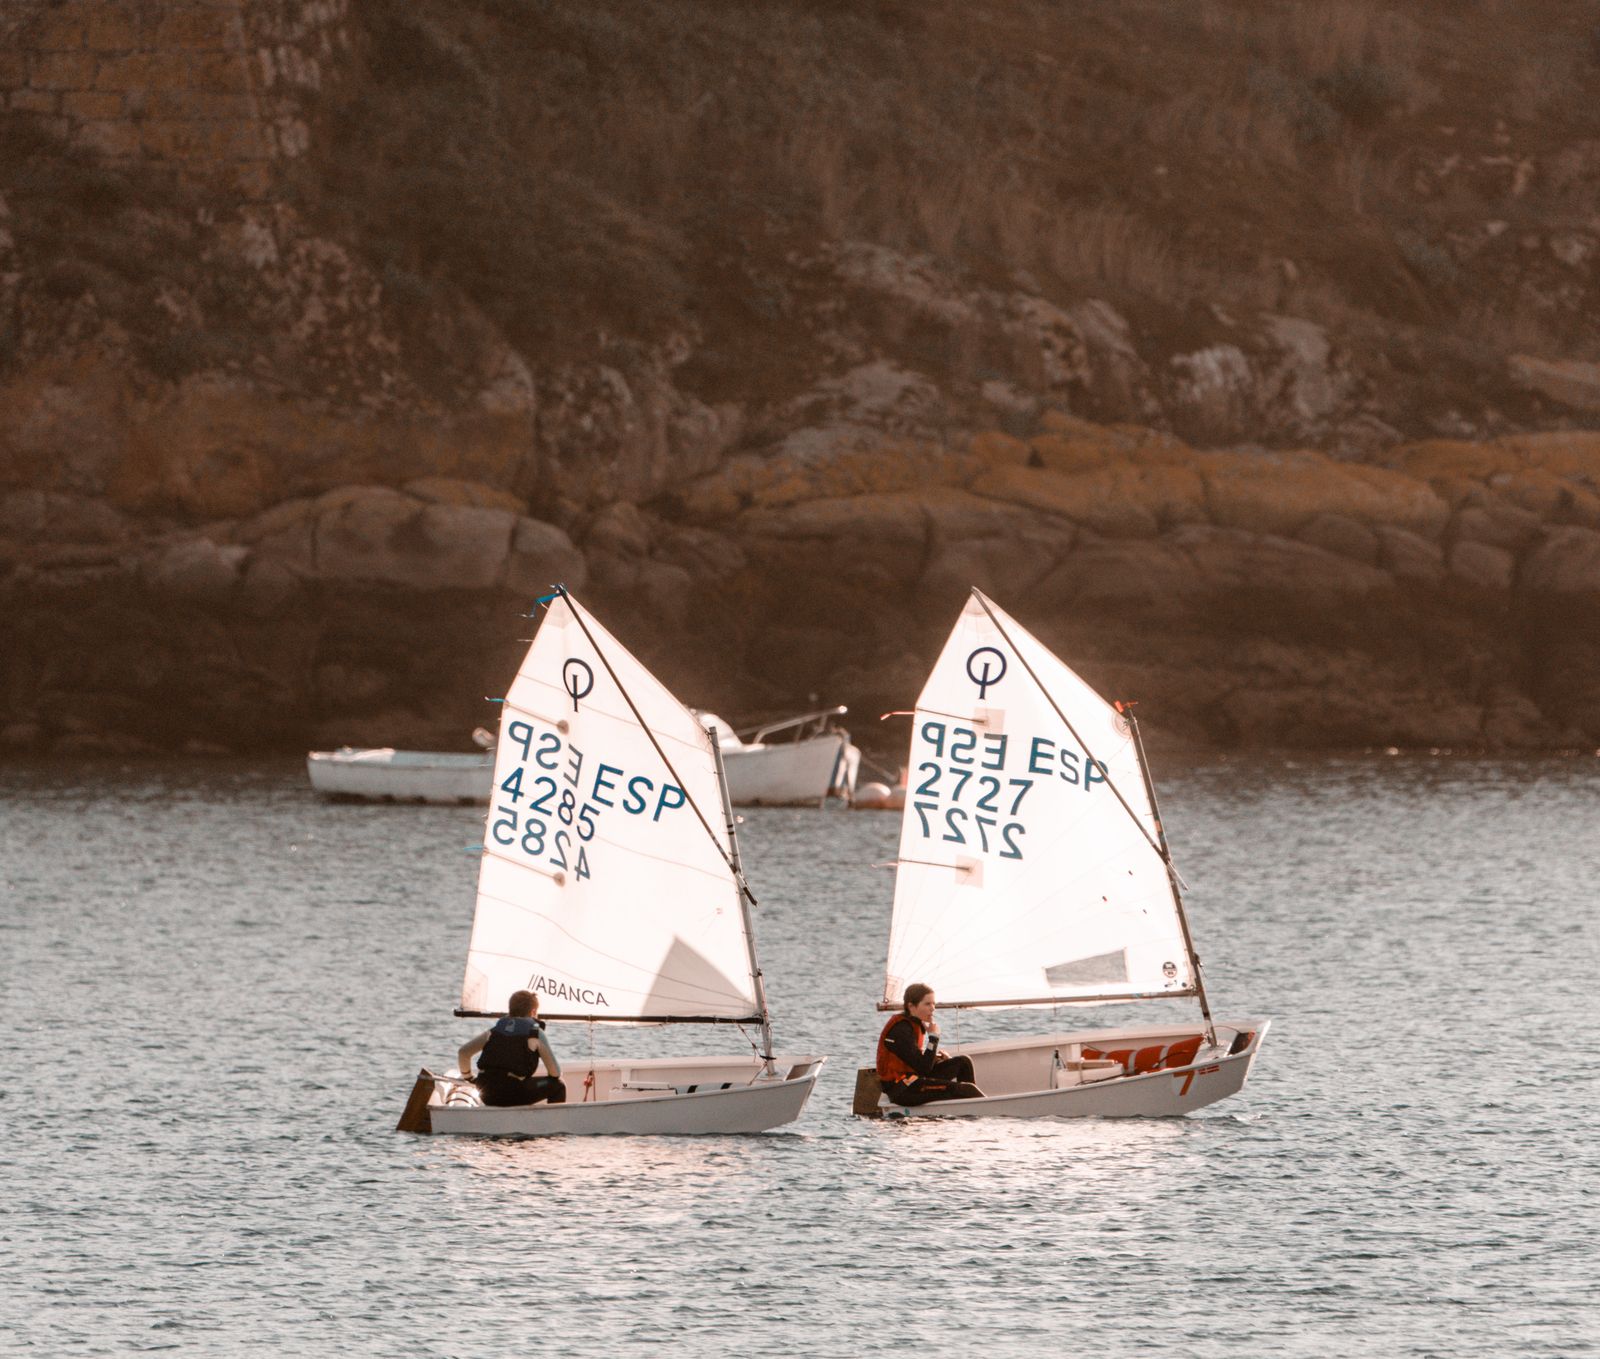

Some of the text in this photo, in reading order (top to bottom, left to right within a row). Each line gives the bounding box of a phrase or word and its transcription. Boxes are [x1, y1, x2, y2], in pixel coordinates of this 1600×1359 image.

[915, 762, 1034, 816] 2727
[1028, 737, 1108, 792] ESP
[501, 767, 600, 842] 4285
[592, 763, 686, 822] ESP
[1173, 1070, 1195, 1097] 7
